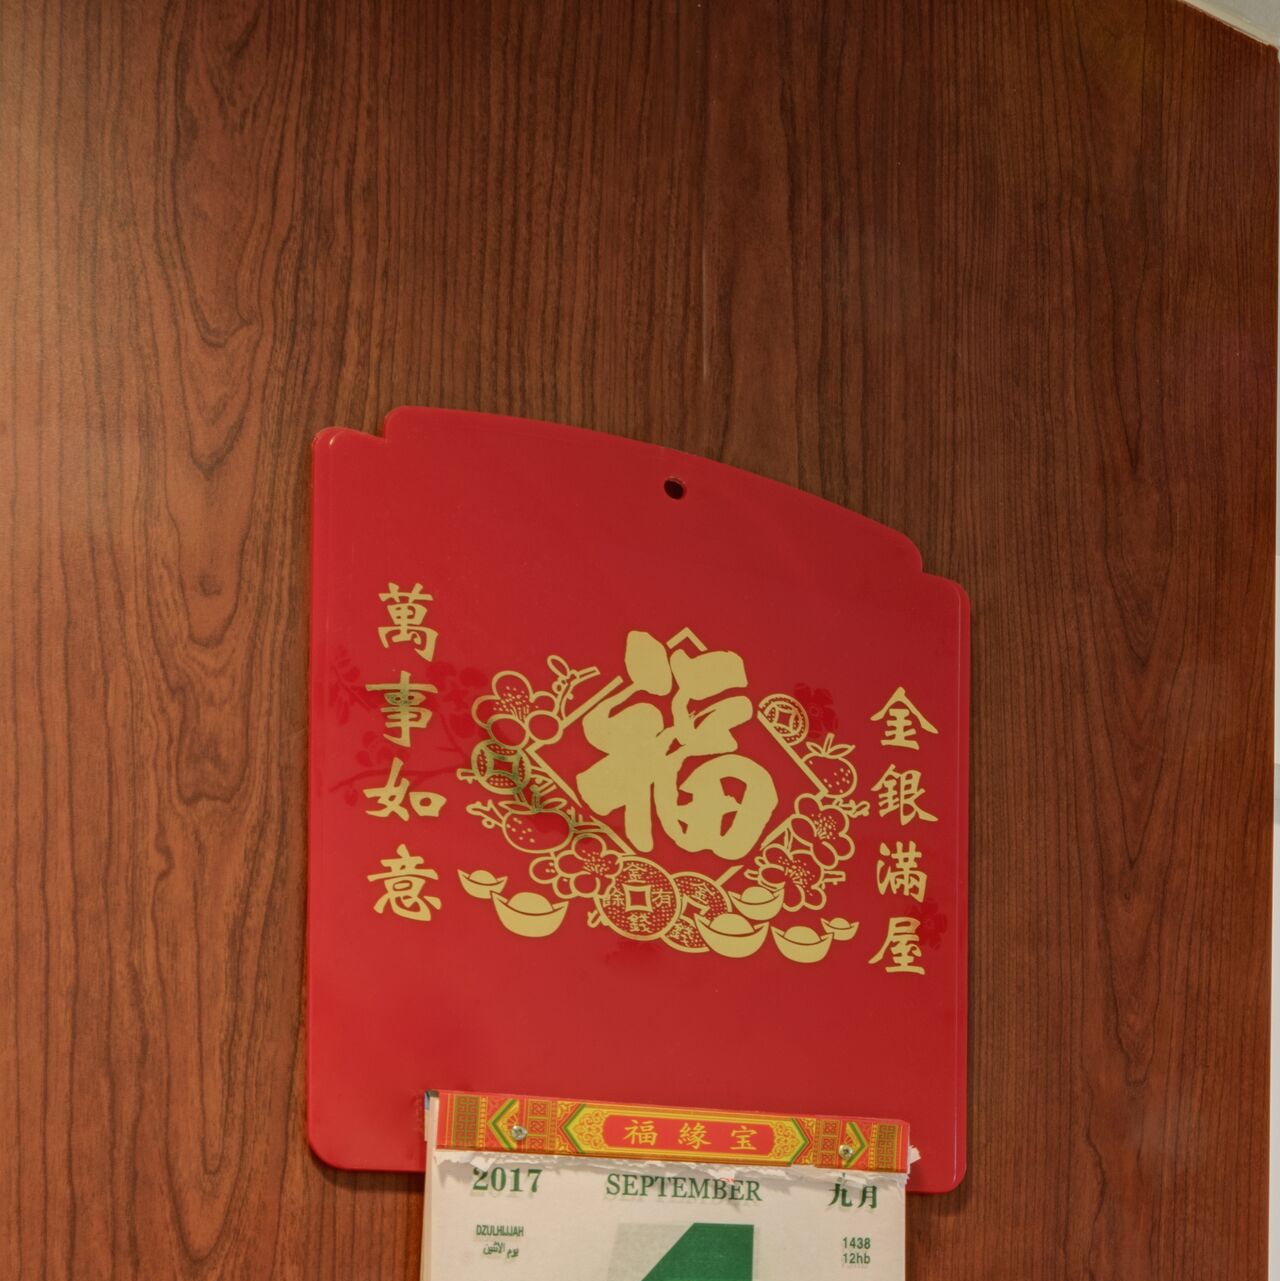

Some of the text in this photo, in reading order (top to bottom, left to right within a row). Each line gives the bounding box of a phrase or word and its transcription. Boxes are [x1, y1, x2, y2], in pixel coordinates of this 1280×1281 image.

[364, 581, 445, 924] 萬事如意
[576, 630, 779, 858] 福
[866, 686, 938, 977] 金銀滿屋
[471, 1166, 543, 1194] 2017
[606, 1172, 763, 1202] SEPTEMBER
[828, 1173, 880, 1209] 九月
[842, 1236, 871, 1250] 1438
[842, 1252, 871, 1264] 12hb
